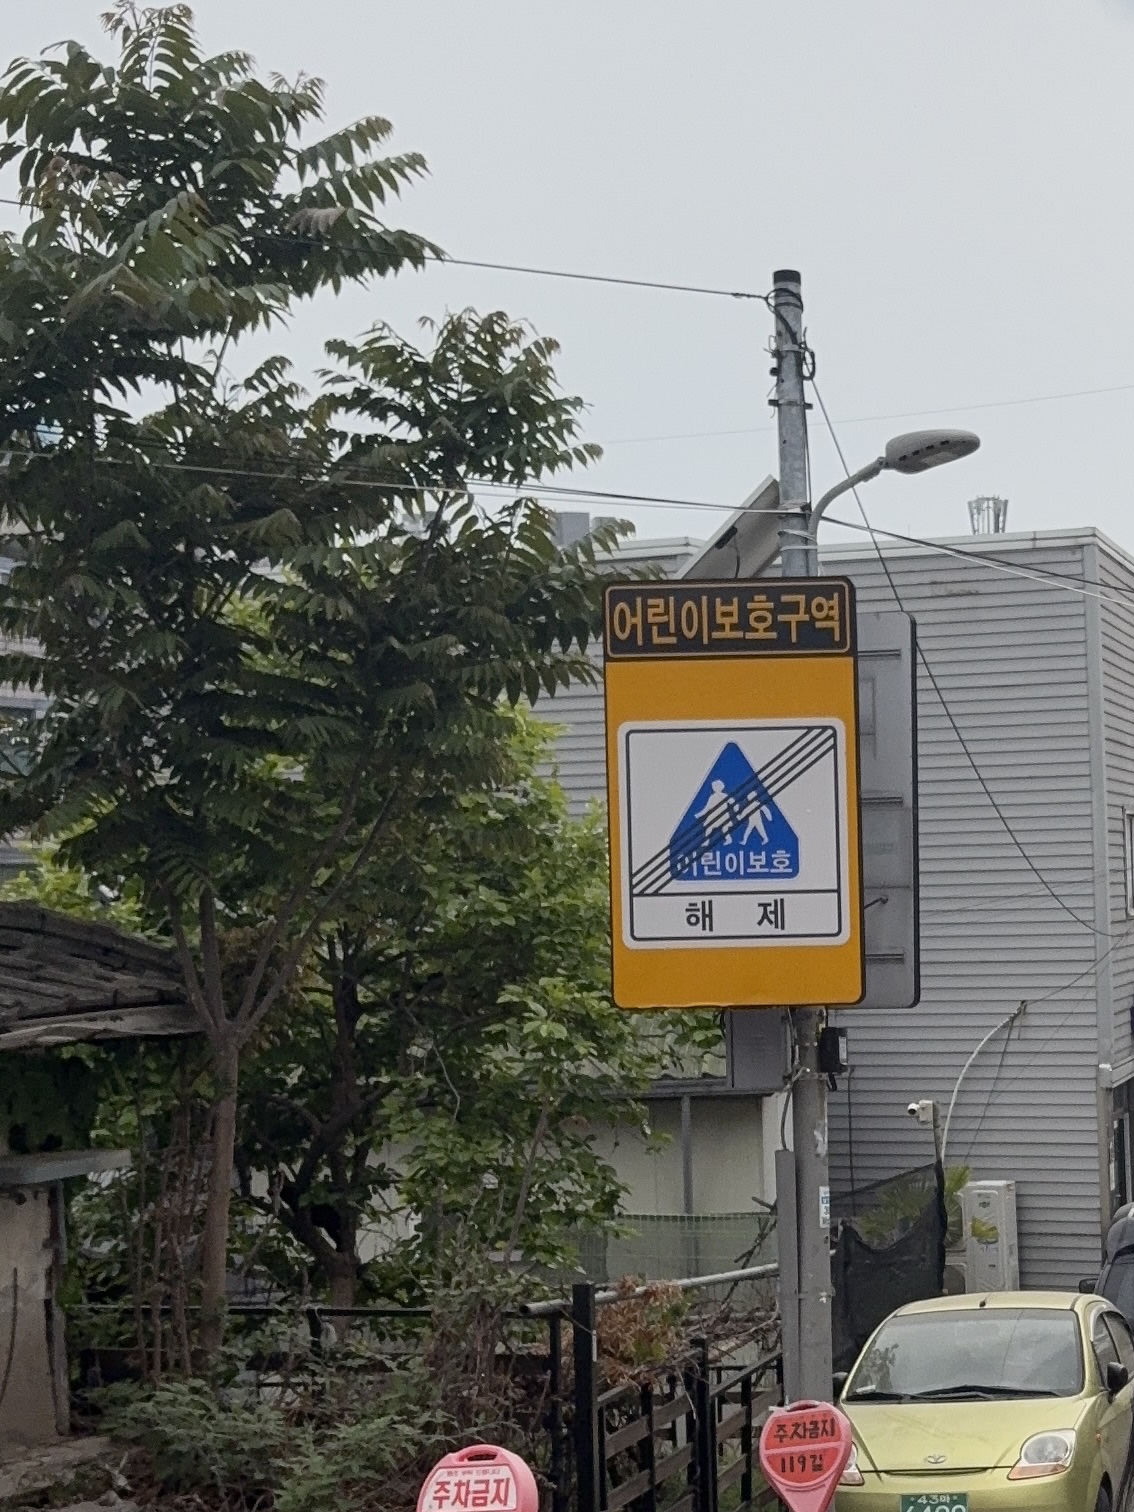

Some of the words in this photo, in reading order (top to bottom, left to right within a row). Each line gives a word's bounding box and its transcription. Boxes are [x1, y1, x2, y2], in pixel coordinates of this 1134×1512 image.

[612, 592, 841, 646] 어린이보호구역
[677, 848, 794, 878] 어린이보호
[432, 1477, 511, 1510] 주차금지
